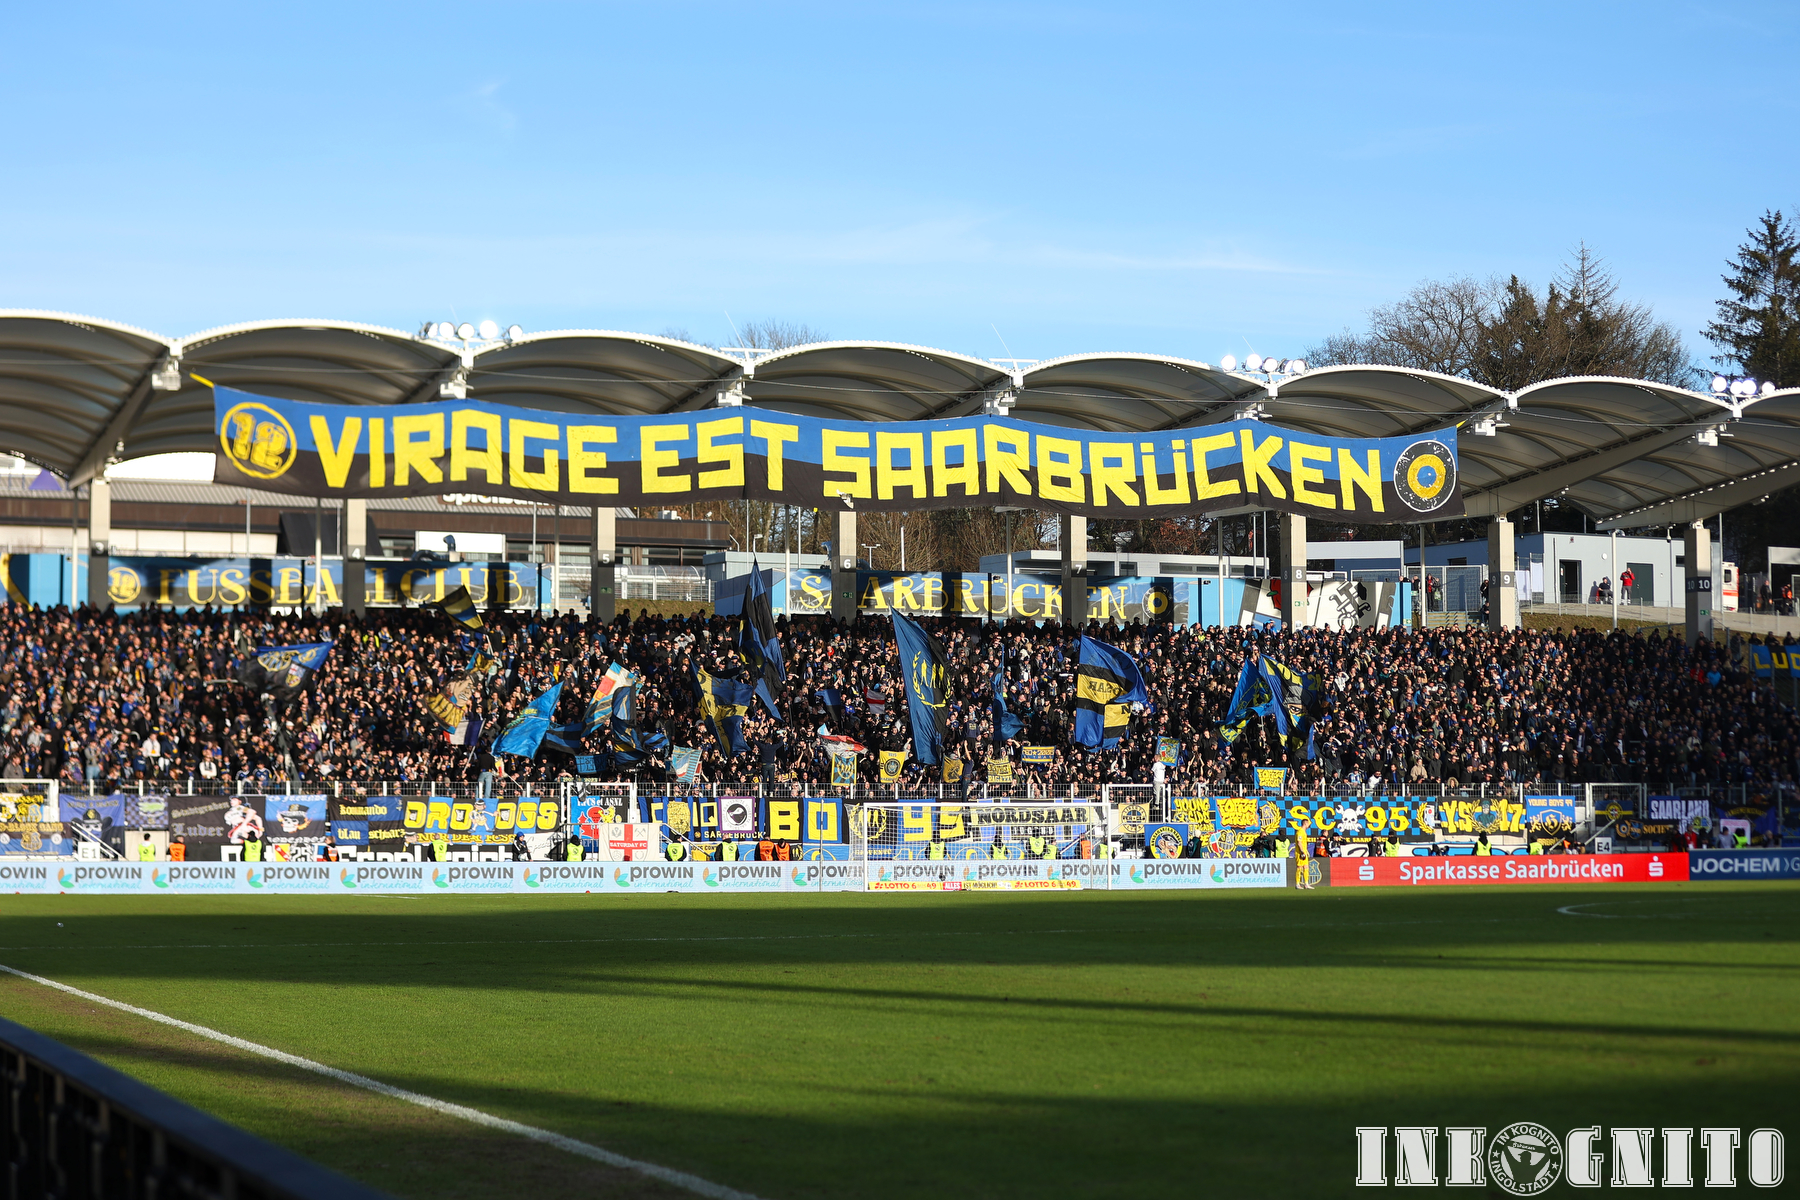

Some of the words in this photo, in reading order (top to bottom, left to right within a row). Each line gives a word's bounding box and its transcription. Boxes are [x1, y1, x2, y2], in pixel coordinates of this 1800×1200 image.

[309, 409, 619, 494] VIRAGE
[640, 416, 799, 494] EST
[822, 424, 1385, 513] SAARBRÜCKEN
[351, 548, 360, 559] 4
[602, 554, 610, 564] 5
[843, 559, 852, 570] 6
[1075, 565, 1083, 575] 7
[1295, 569, 1303, 580] 8
[1503, 574, 1511, 585] 9
[1698, 579, 1711, 590] 10
[799, 574, 1129, 620] SARBRÜCKN
[1527, 798, 1548, 806] YOUNG
[1548, 798, 1564, 806] BOYS
[403, 801, 559, 831] DROOGS
[977, 807, 1089, 823] NORDSAAR
[1364, 806, 1411, 832] 95
[1597, 841, 1610, 853] E4
[1399, 860, 1500, 885] Sparkasse
[1505, 856, 1625, 880] Saarbrücken
[1690, 857, 1781, 874] JOCHEM
[885, 882, 910, 890] LOTTO
[926, 882, 937, 890] 49
[944, 882, 962, 890] ALLES
[1024, 881, 1050, 889] LOTTO
